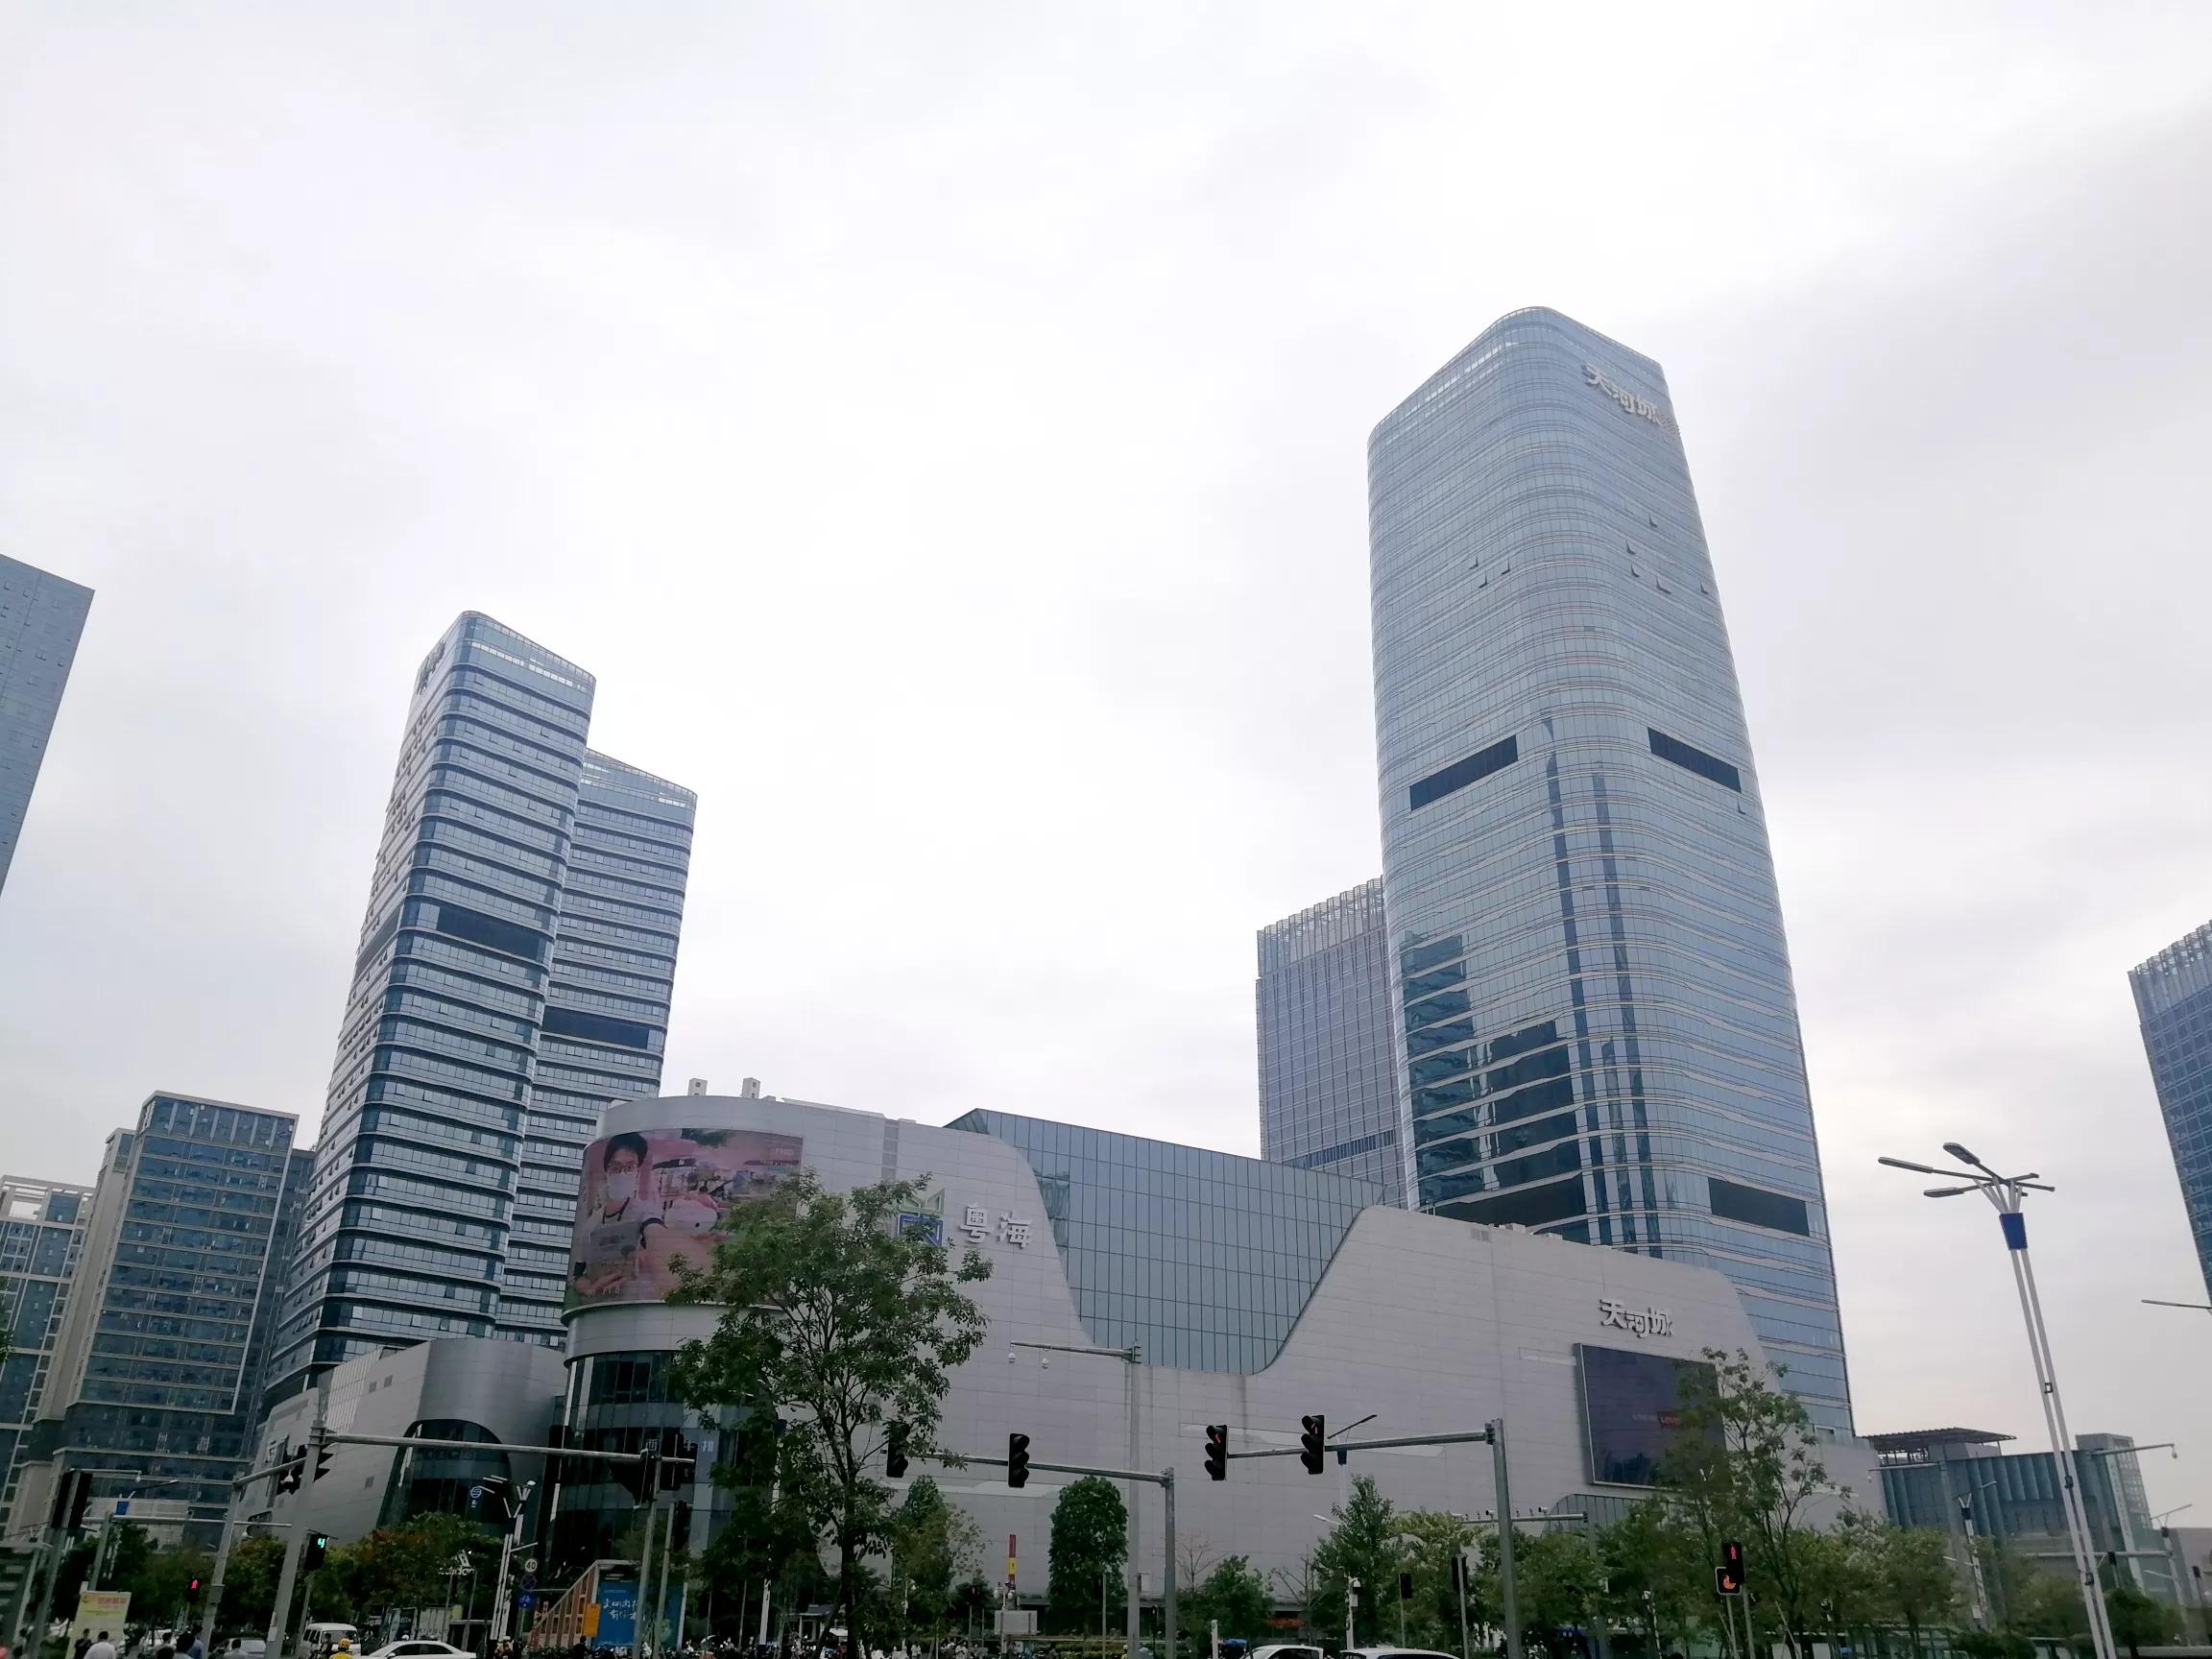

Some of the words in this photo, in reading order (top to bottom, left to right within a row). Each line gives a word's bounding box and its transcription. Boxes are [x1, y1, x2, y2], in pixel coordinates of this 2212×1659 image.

[1581, 362, 1663, 428] 天河城
[960, 1202, 1034, 1250] 粤海
[1599, 1298, 1675, 1338] 天河城
[645, 1438, 715, 1453] 西牛排
